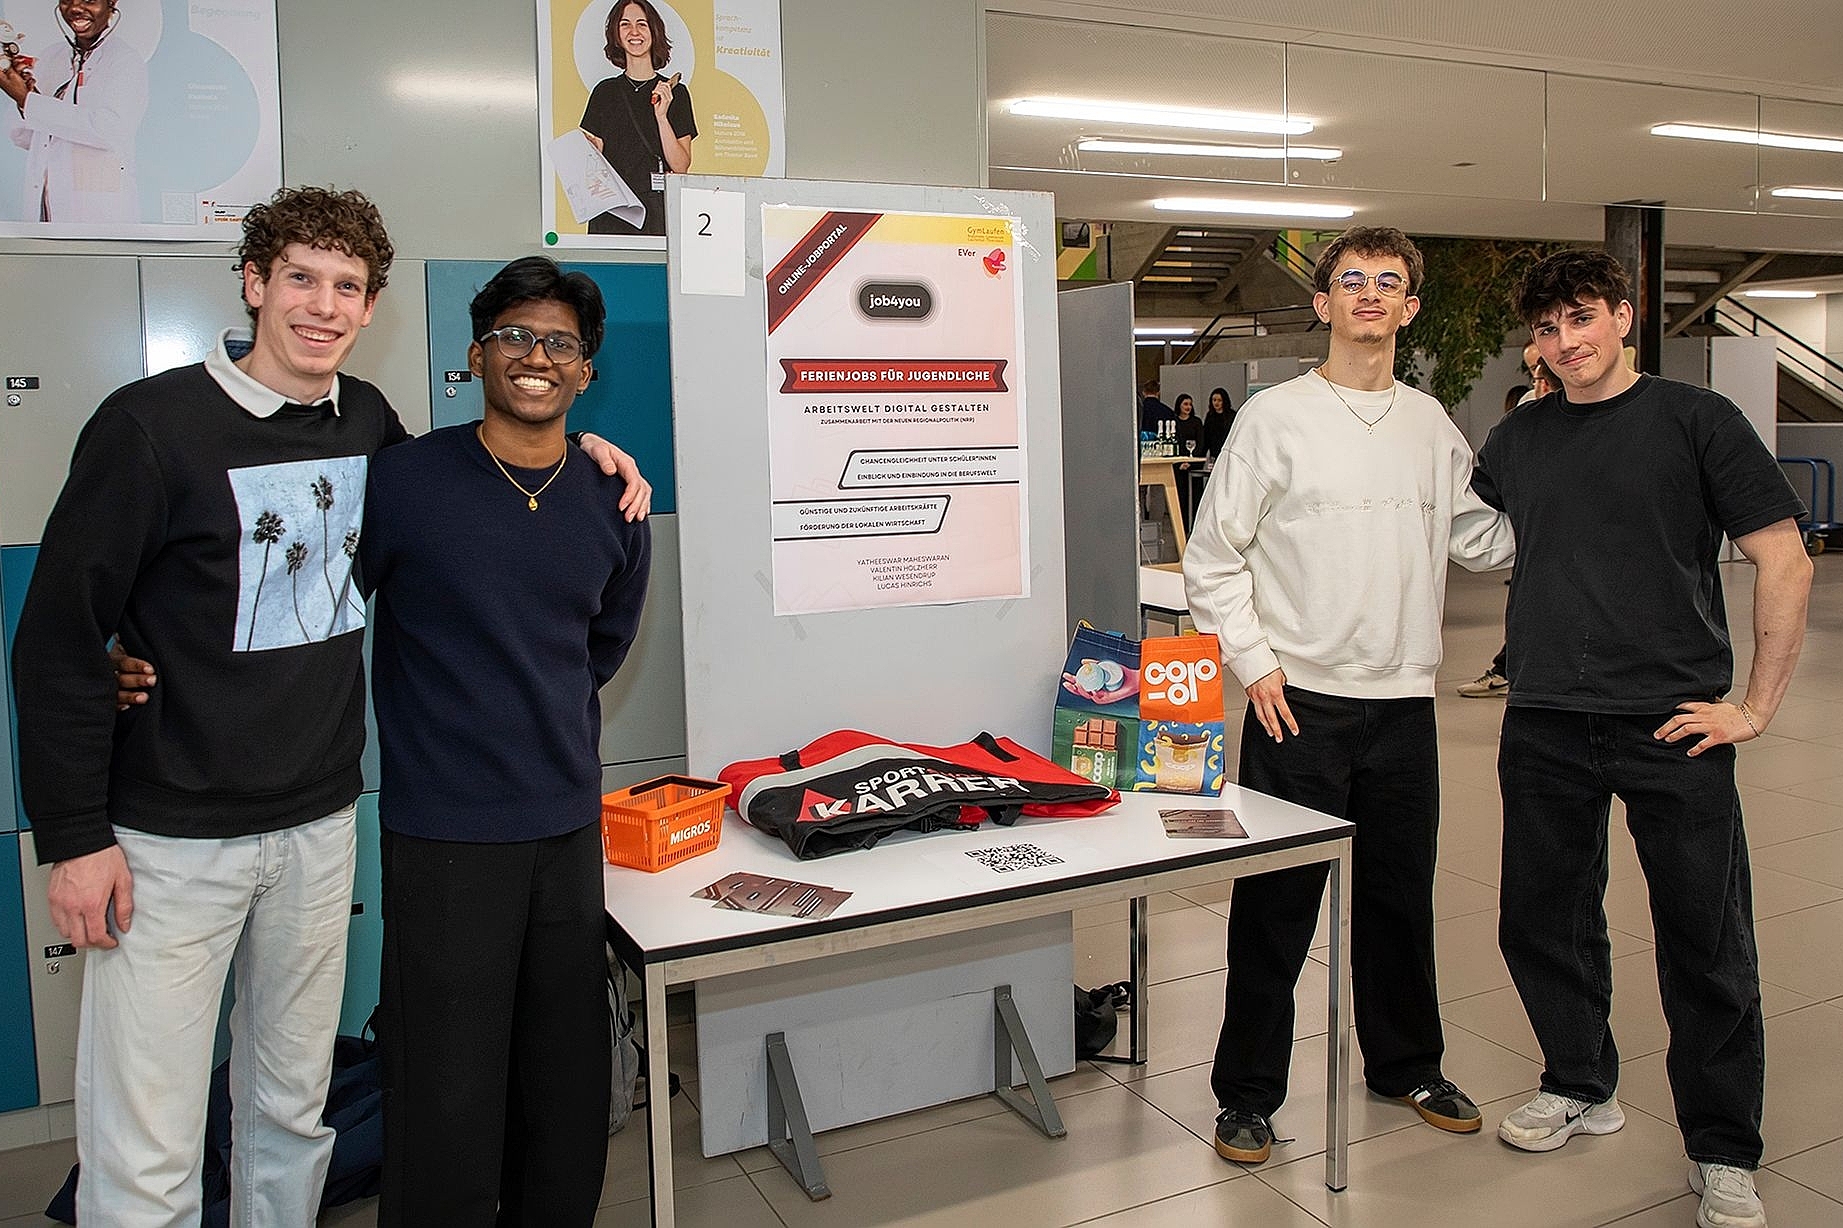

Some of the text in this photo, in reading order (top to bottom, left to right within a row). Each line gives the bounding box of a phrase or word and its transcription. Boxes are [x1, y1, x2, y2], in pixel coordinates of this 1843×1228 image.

[698, 213, 712, 236] 2
[778, 224, 847, 294] ONLINE-JOBPORTAL
[869, 294, 921, 309] job4you
[448, 372, 460, 381] 154
[800, 369, 990, 381] FERIENJOBS FÜR JUGENDLICHE
[10, 378, 26, 388] 145
[804, 404, 989, 414] ARBEITSWELT DIGITAL GESTALTEN
[860, 457, 927, 465] CHANCENGLEICHHEIT
[889, 503, 937, 511] ARBEITSKRÄFTE
[857, 555, 950, 566] YATHEESWAR MAHESWARAN
[854, 766, 926, 794] SPORT
[815, 774, 1031, 819] KARRER
[670, 820, 711, 846] MIGROS
[49, 946, 63, 956] 147
